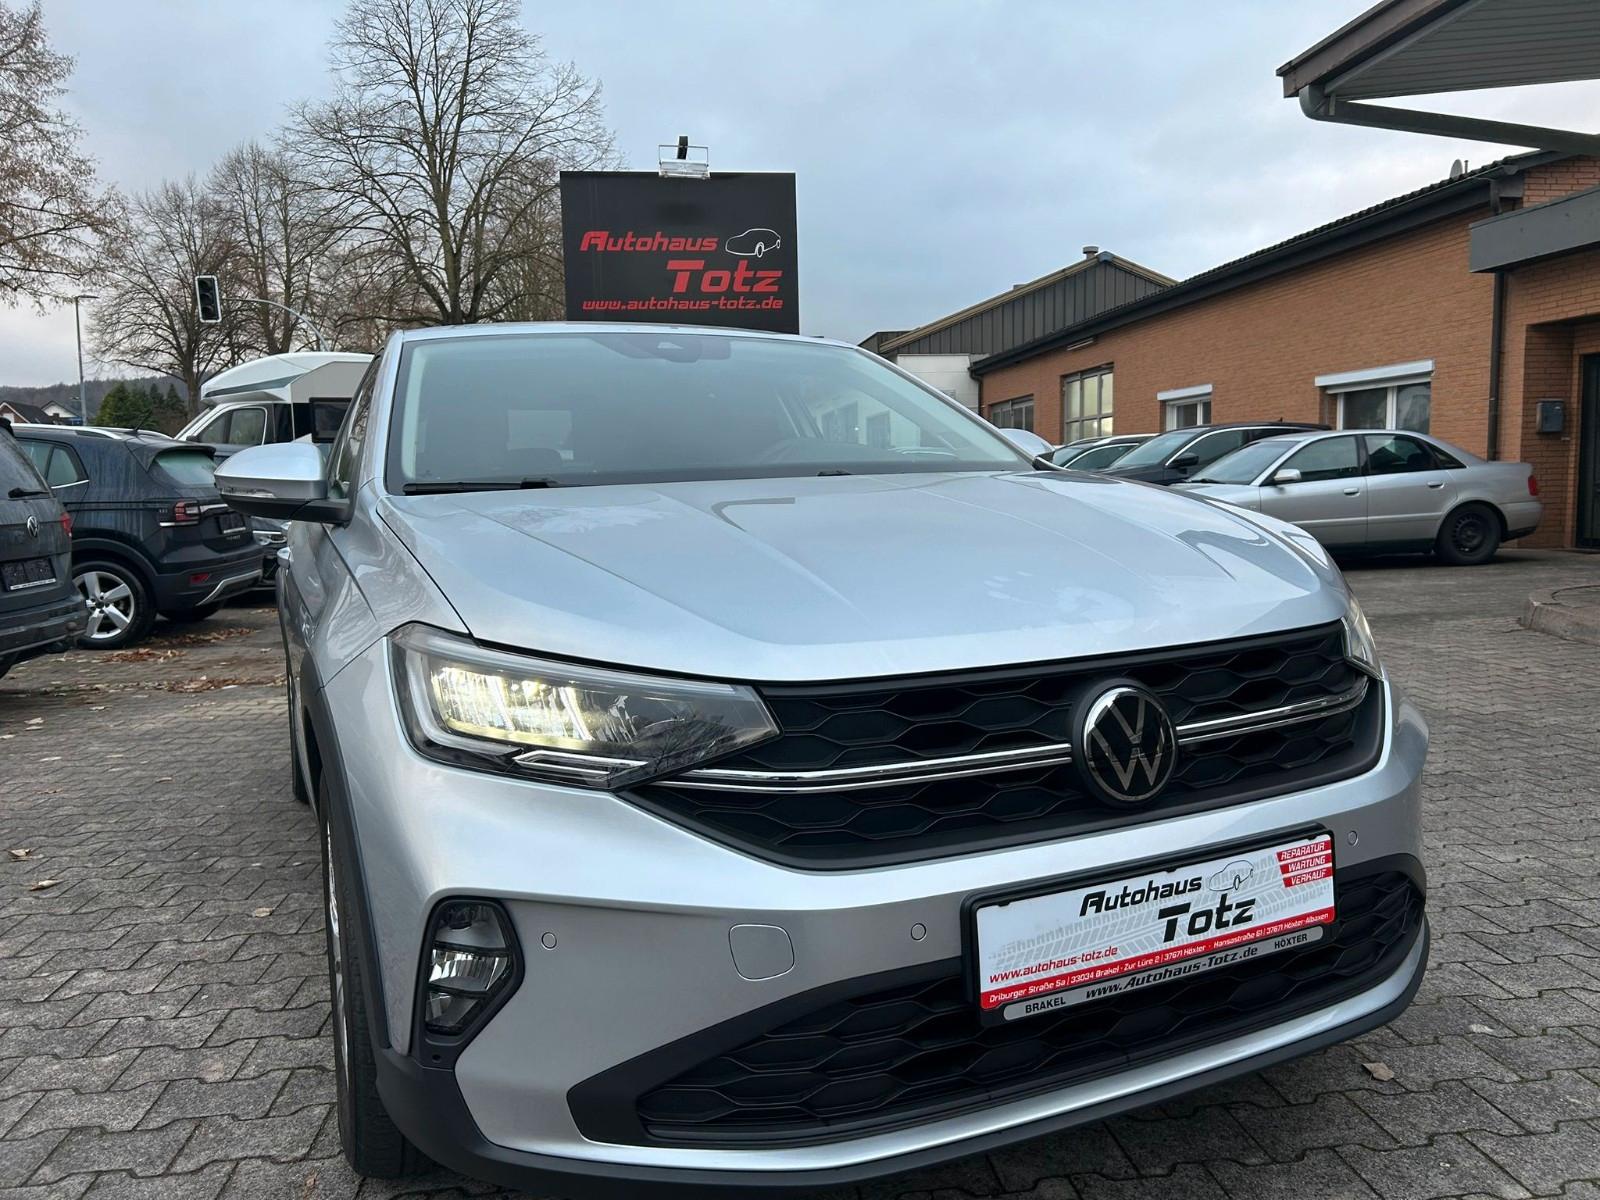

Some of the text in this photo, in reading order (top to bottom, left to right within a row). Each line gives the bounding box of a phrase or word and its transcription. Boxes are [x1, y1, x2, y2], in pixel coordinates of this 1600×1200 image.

[580, 231, 720, 252] Autohaus
[666, 260, 783, 293] Totz
[582, 296, 784, 310] www.autohaus-totz.de
[1281, 842, 1325, 860] REPARATUR
[1288, 855, 1326, 872] WARTUNG
[1290, 869, 1327, 885] VERKAUF
[1079, 876, 1203, 917] Autohaus
[1158, 893, 1256, 943] Totz
[989, 945, 1118, 984] www.autohaus-totz.de
[1025, 996, 1066, 1014] BRAKEL
[1085, 946, 1258, 999] www.Autohaus-Totz.de
[989, 988, 1026, 1003] Driburger
[1028, 981, 1055, 994] Straße
[1070, 971, 1094, 983] 33034
[1095, 965, 1120, 978] Brakel
